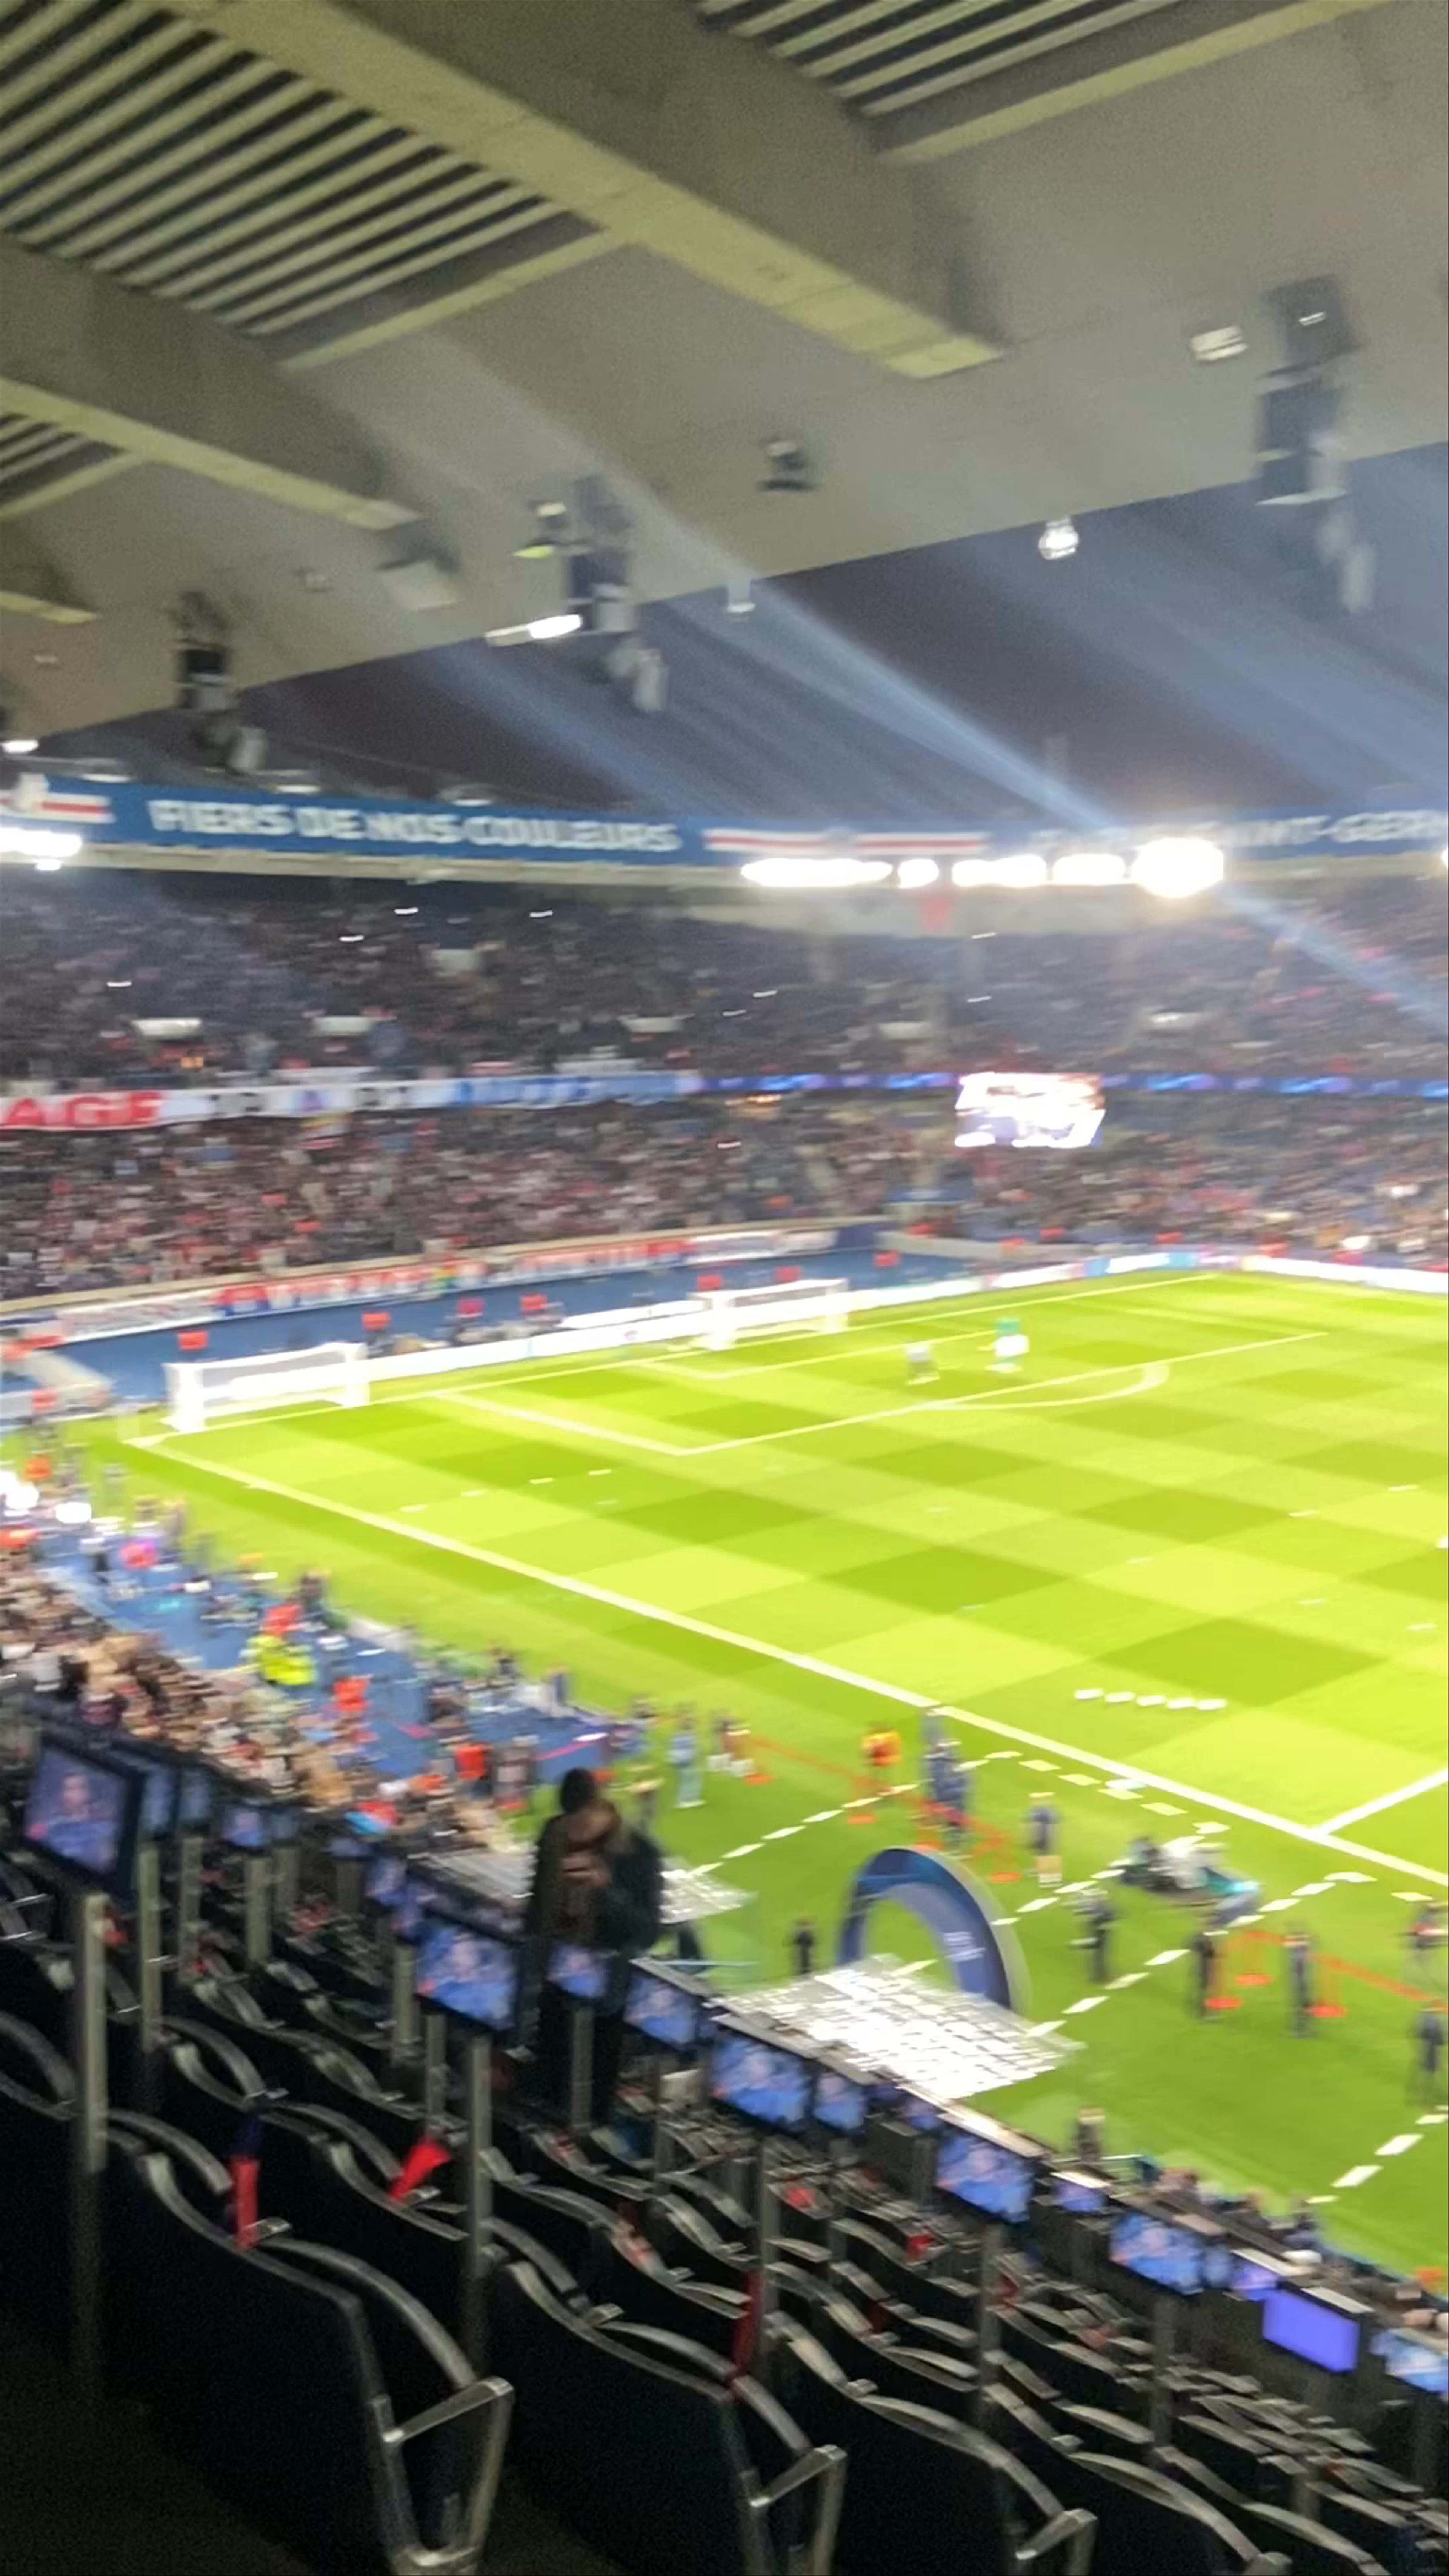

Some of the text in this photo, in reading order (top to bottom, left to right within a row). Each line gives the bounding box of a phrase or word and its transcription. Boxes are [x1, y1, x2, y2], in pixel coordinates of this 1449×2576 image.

[146, 800, 681, 852] FIERS DE NOS COULEURS
